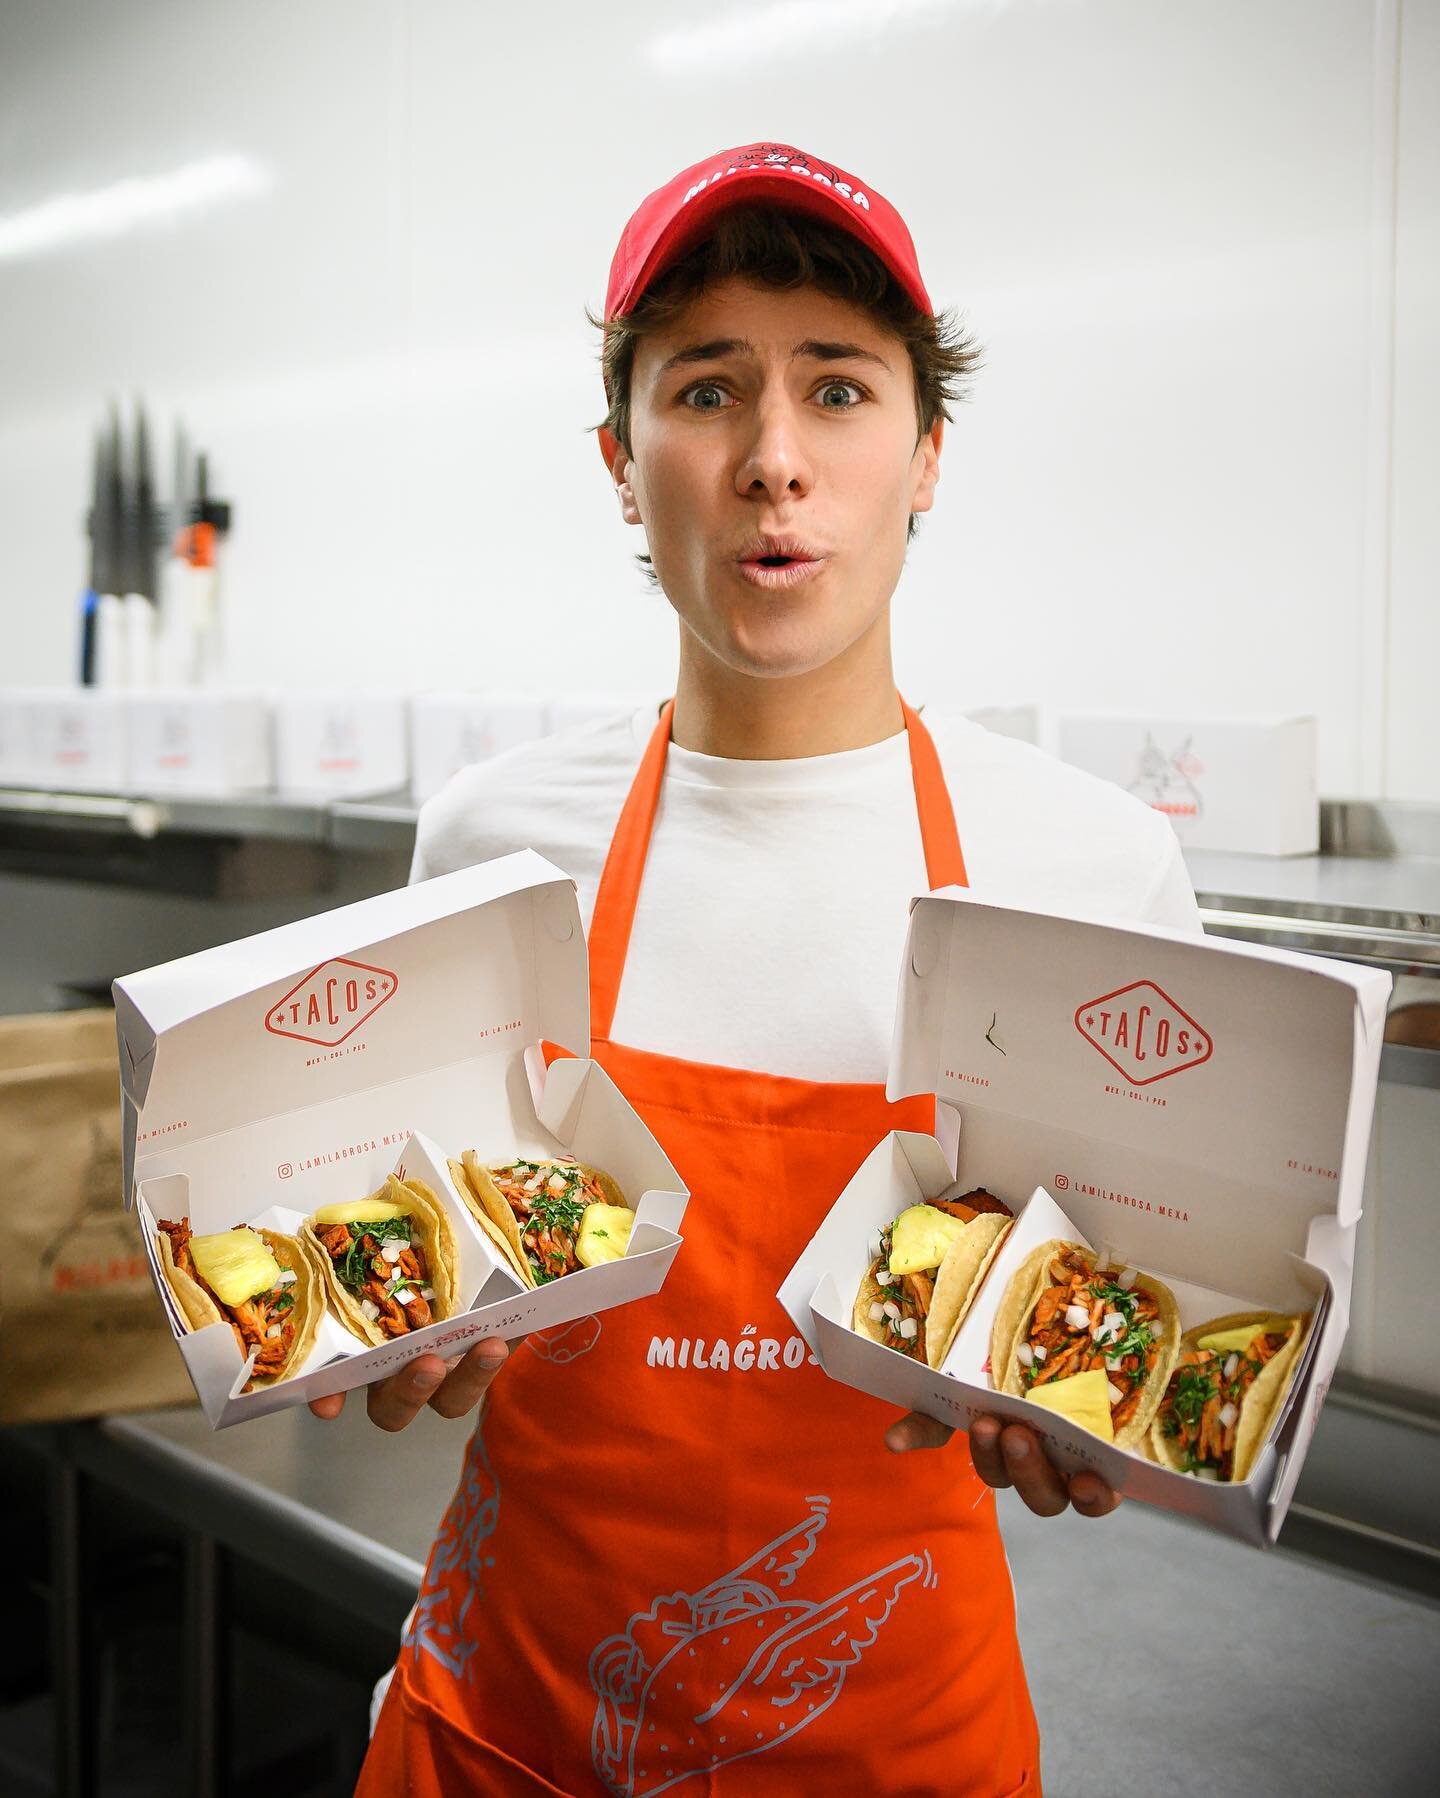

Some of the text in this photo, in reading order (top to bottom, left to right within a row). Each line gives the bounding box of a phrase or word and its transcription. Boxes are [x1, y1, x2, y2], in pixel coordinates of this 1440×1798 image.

[290, 979, 376, 1025] TACOS
[1100, 1006, 1189, 1060] TACOS
[151, 1121, 188, 1136] MILAGRO
[646, 1336, 819, 1371] MILAGRO
